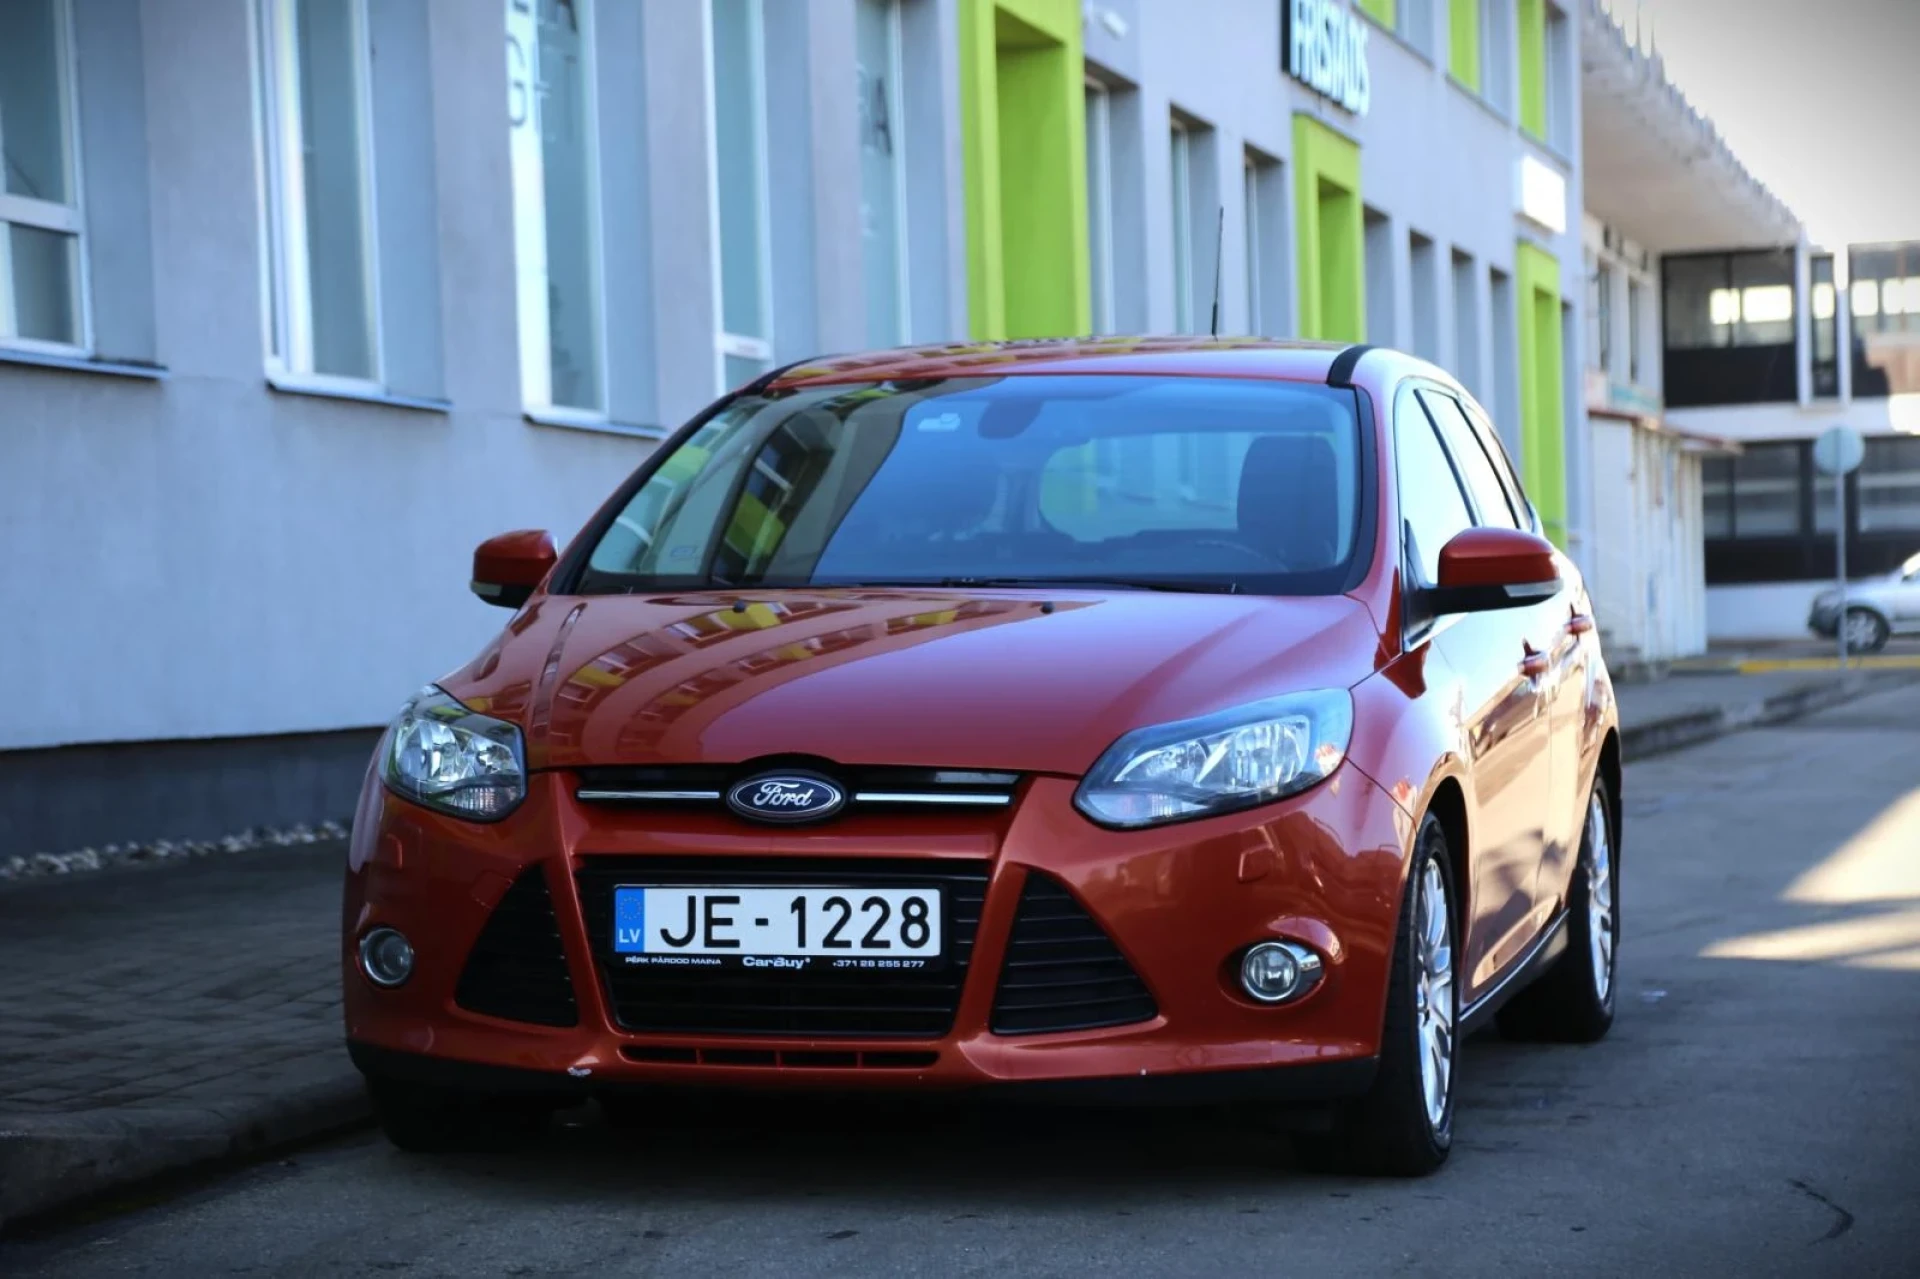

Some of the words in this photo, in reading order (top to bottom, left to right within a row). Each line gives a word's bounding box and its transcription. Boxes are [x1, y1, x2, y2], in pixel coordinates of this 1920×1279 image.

[752, 782, 814, 806] Ford
[659, 895, 931, 950] JE-1228
[619, 929, 642, 944] LV
[691, 957, 722, 966] MAINA
[832, 959, 858, 968] +371
[902, 959, 925, 969] 277
